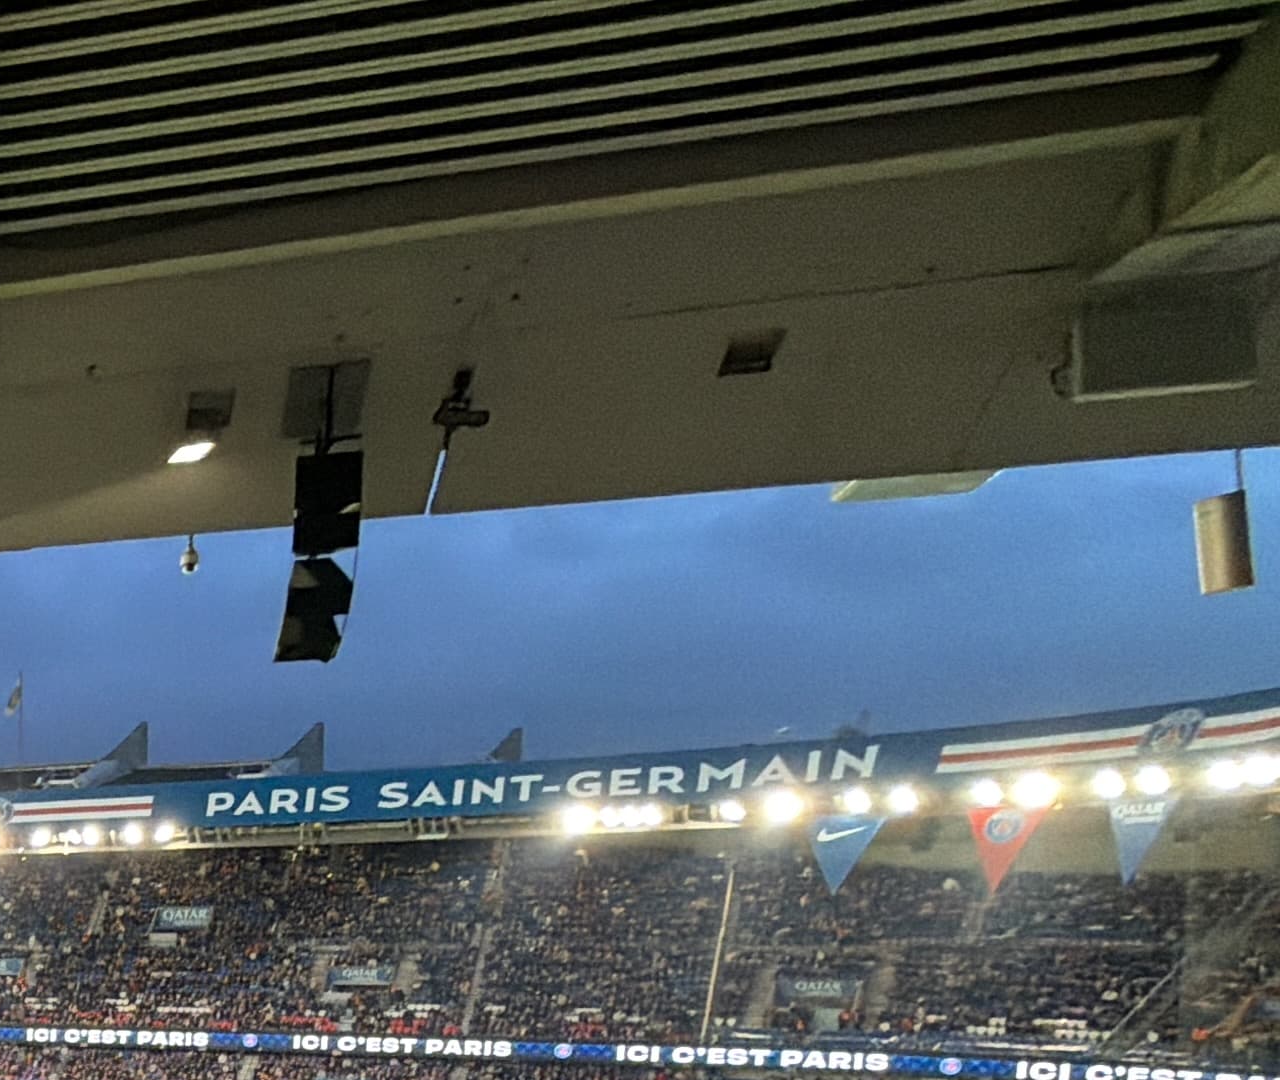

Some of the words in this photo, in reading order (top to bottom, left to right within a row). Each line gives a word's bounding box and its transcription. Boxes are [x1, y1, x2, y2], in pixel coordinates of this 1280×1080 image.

[206, 784, 351, 818] PARIS
[377, 743, 881, 808] SAINT-GERMAIN
[26, 1028, 57, 1042] ICI
[64, 1028, 132, 1045] C'EST
[137, 1031, 209, 1048] PARIS
[293, 1035, 328, 1050] ICI
[337, 1036, 418, 1053] C'EST
[424, 1038, 512, 1057] PARIS
[616, 1045, 659, 1062] ICI
[671, 1047, 771, 1067] C'EST
[780, 1050, 889, 1071] PARIS
